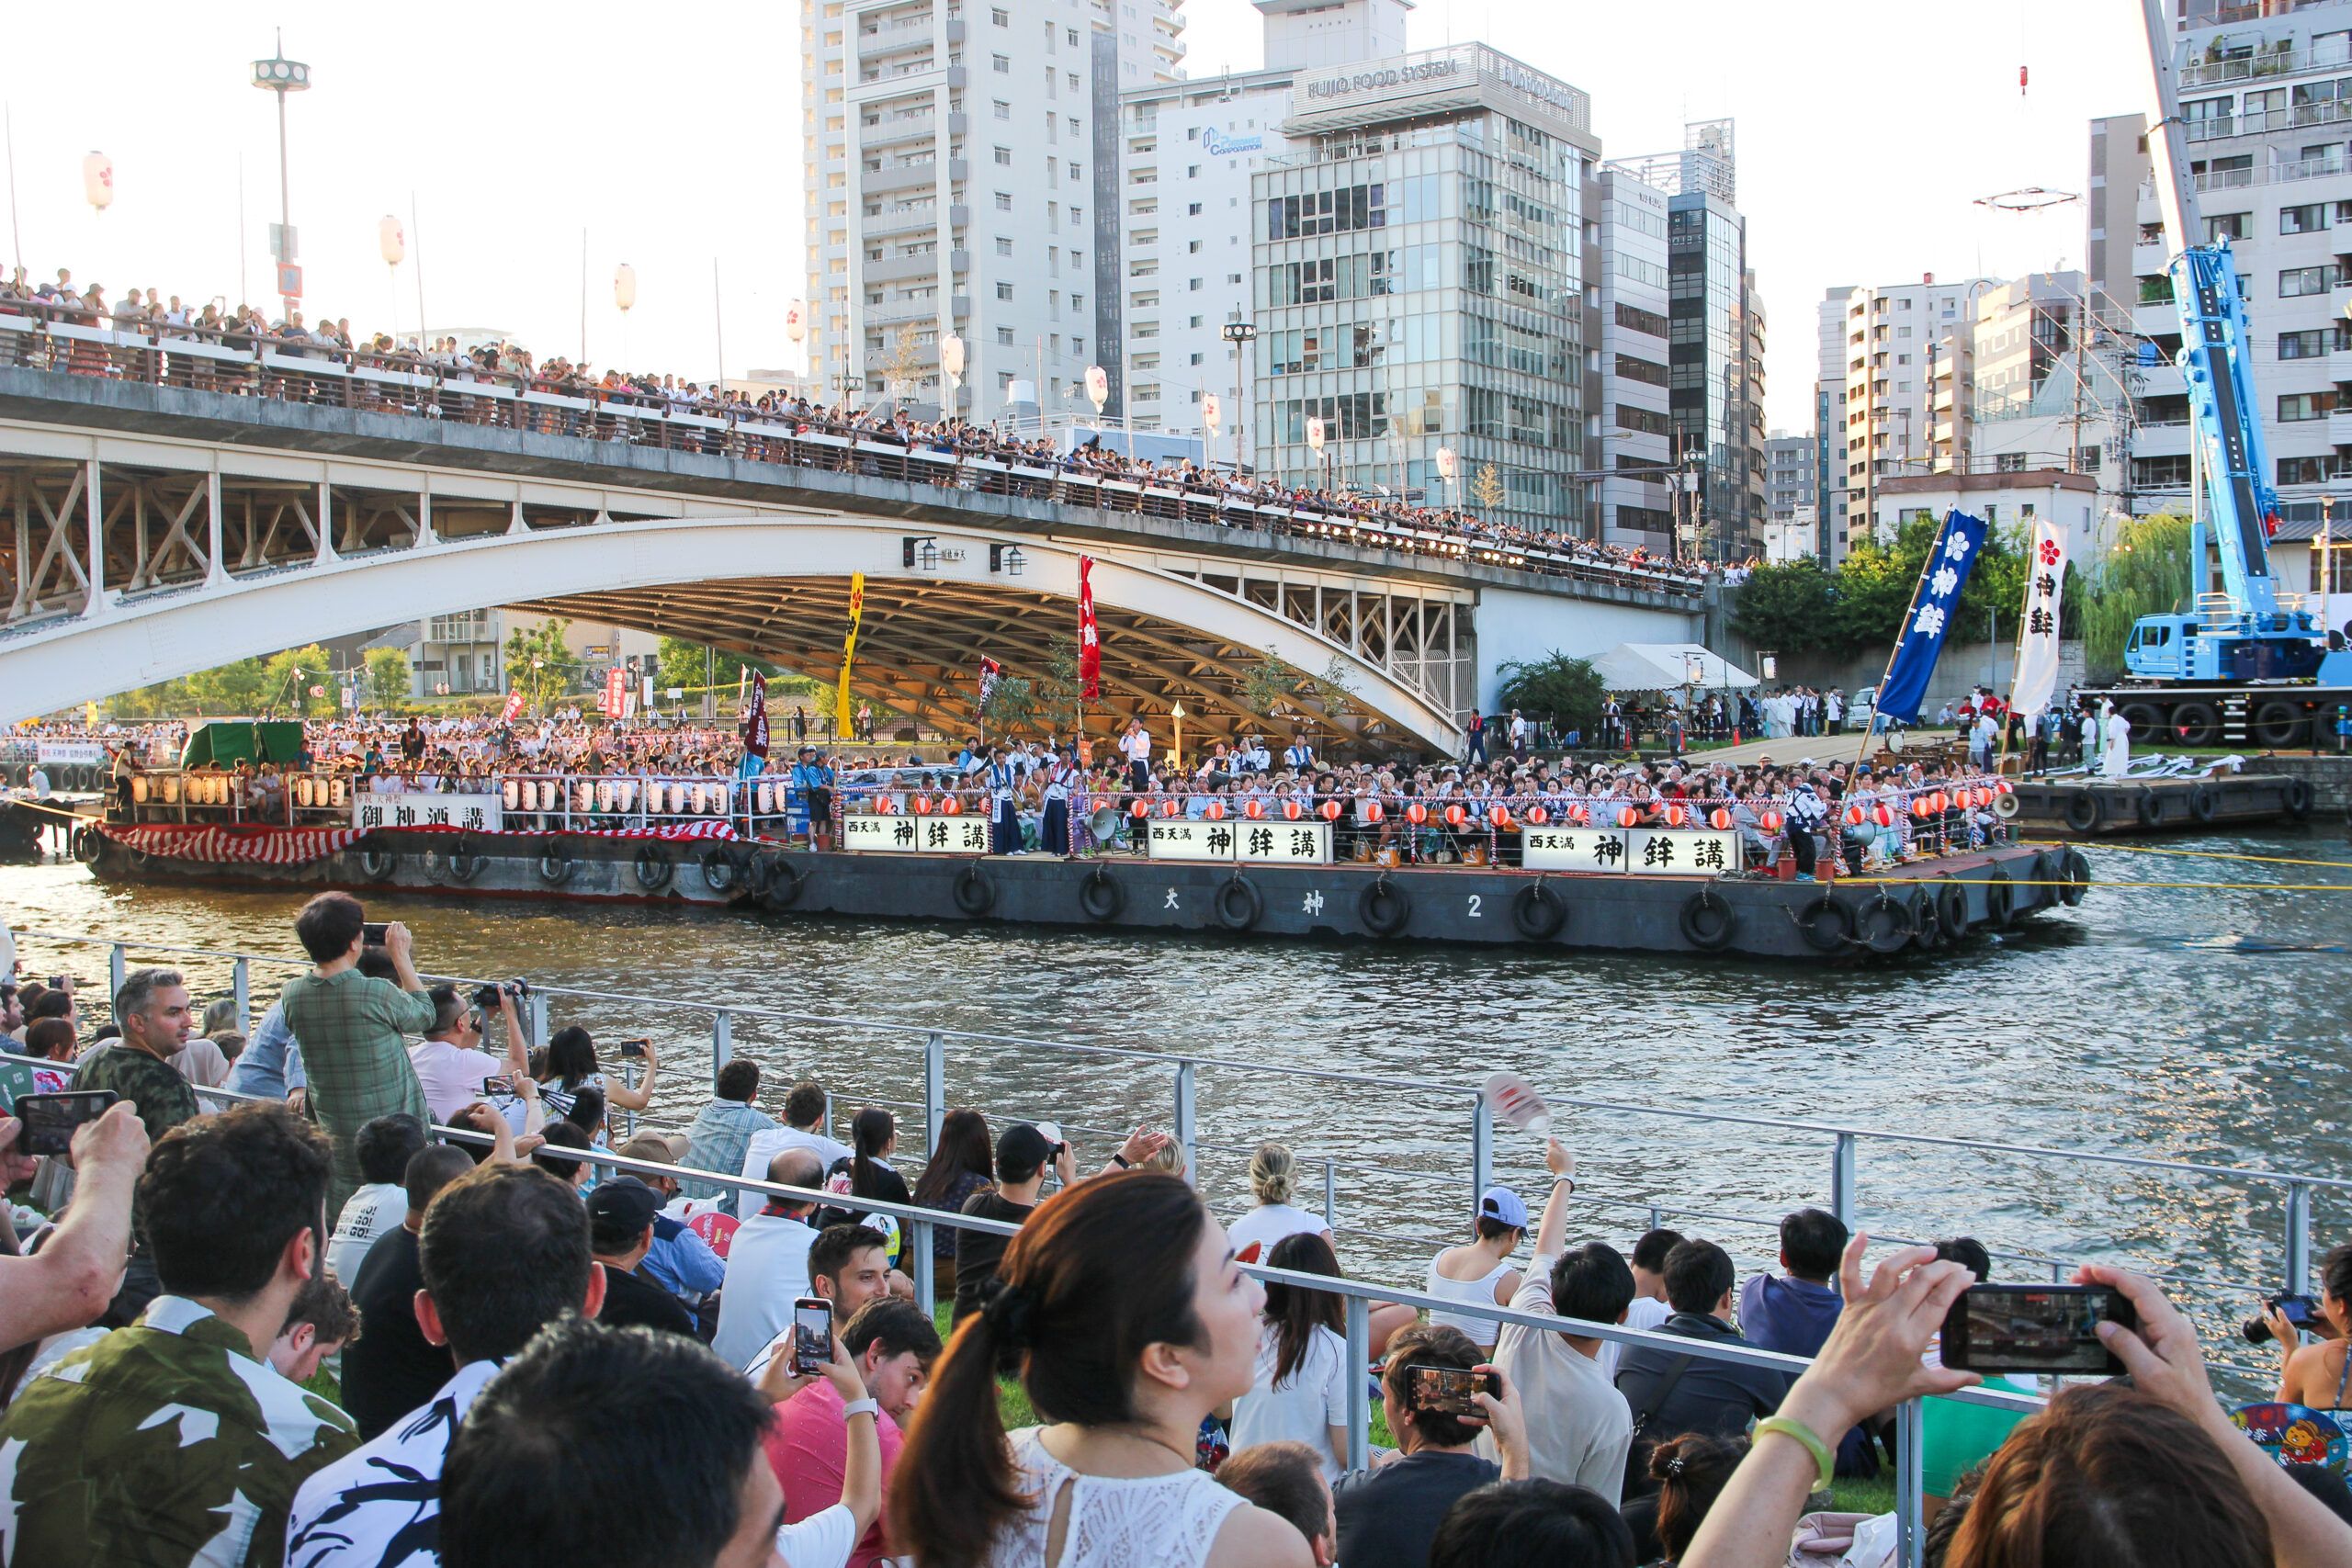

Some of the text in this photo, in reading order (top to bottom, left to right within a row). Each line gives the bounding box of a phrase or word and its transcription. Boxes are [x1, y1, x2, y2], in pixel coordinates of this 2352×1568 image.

[1308, 59, 1458, 98] FUJIO FOOD SYSTEM
[1210, 142, 1262, 155] CORPORATION
[2030, 570, 2056, 639] 神鉾
[343, 690, 350, 703] 2
[598, 692, 606, 707] 2
[361, 805, 485, 830] 御神酒講
[848, 819, 985, 851] 西天満 神鉾講
[1152, 827, 1316, 858] 西天満 神鉾講
[1530, 834, 1725, 870] 西天満 神鉾講
[1164, 888, 1481, 917] 大 神 2
[349, 1226, 369, 1238] GO!
[355, 1215, 373, 1227] GO!
